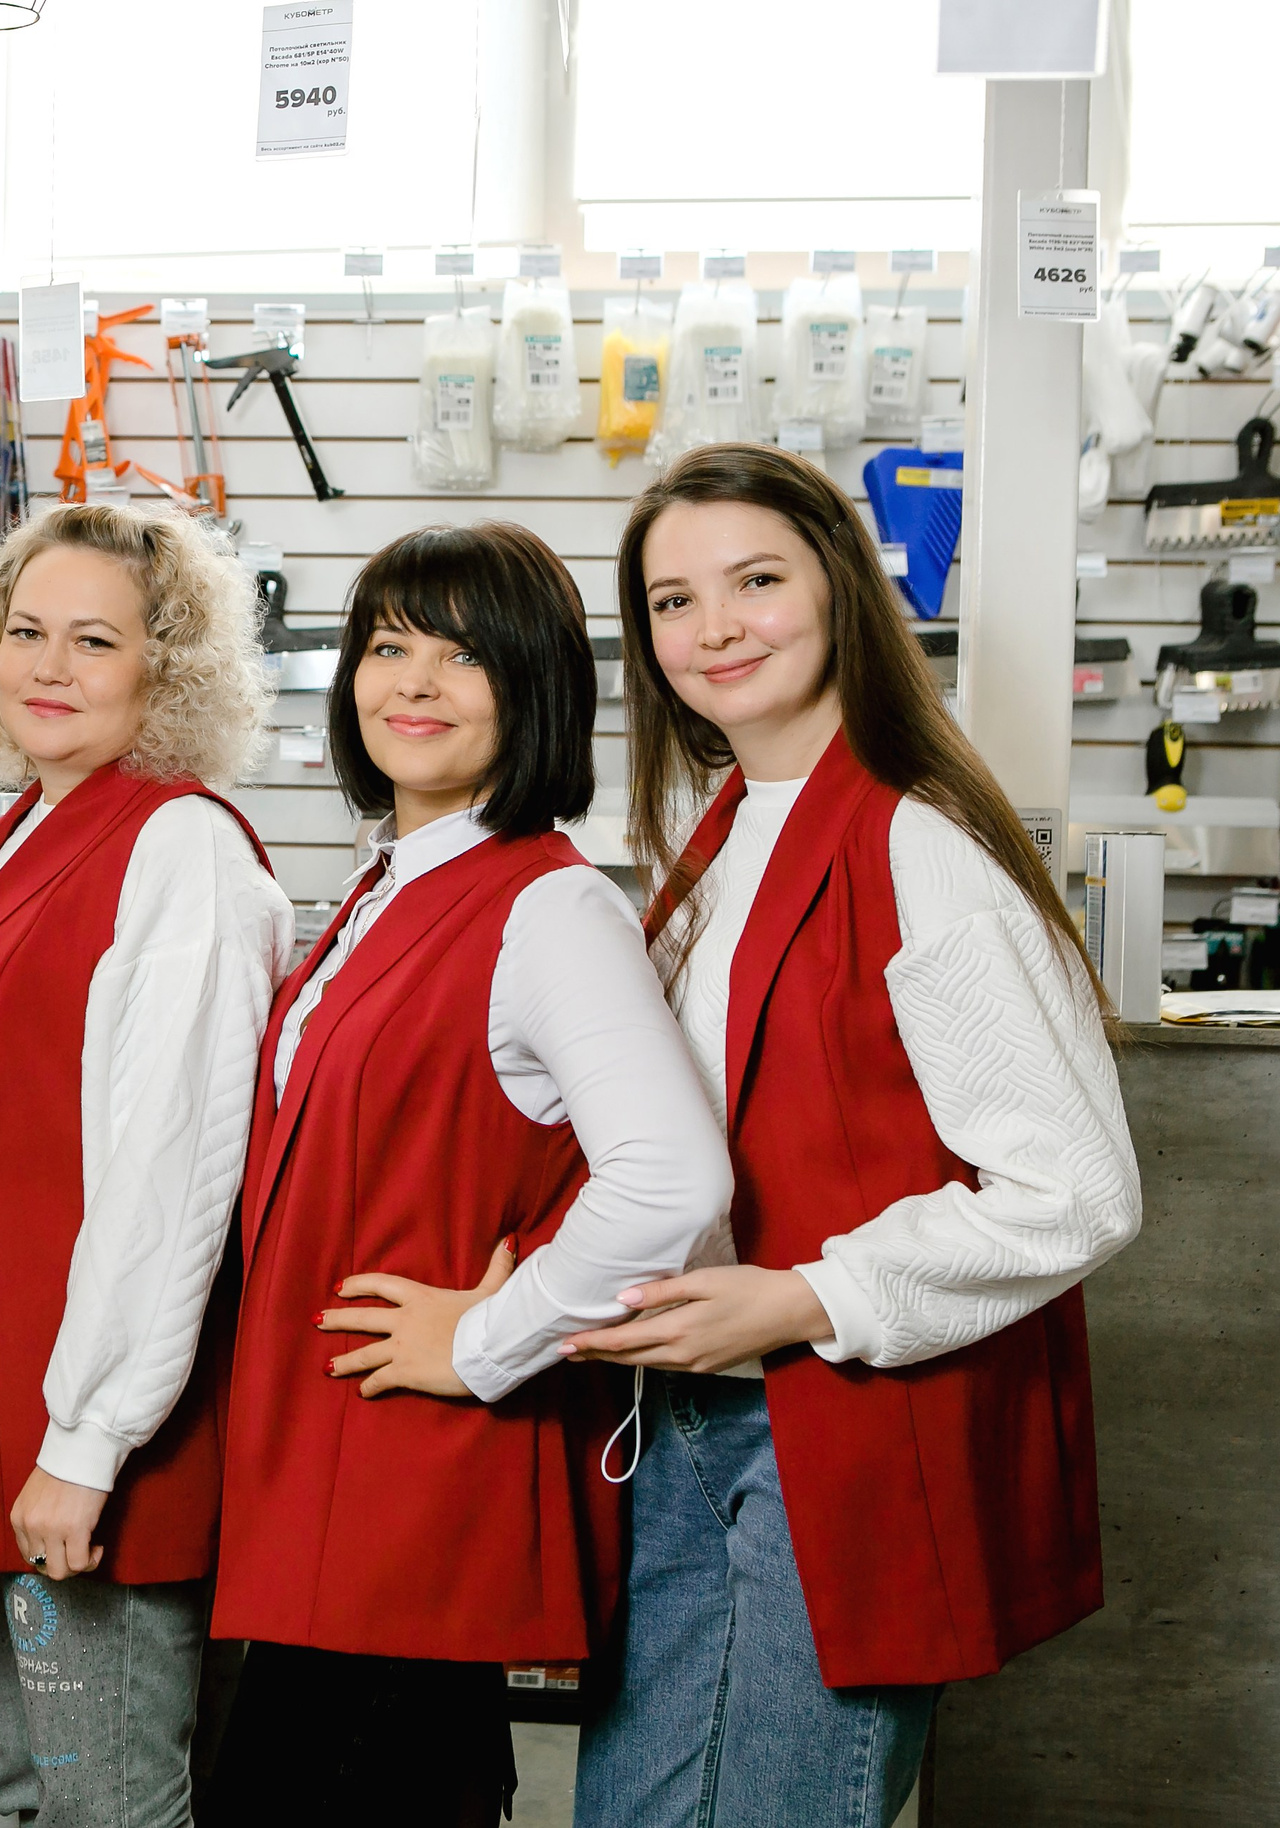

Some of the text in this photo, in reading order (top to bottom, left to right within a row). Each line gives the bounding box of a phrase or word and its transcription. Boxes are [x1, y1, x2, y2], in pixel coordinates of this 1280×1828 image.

[284, 7, 333, 19] КУБОМЕТР
[269, 40, 347, 52] Потолочный светильник
[275, 85, 337, 109] 5940
[327, 107, 346, 118] руб.
[1033, 267, 1087, 283] 4626
[13, 1593, 29, 1625] R
